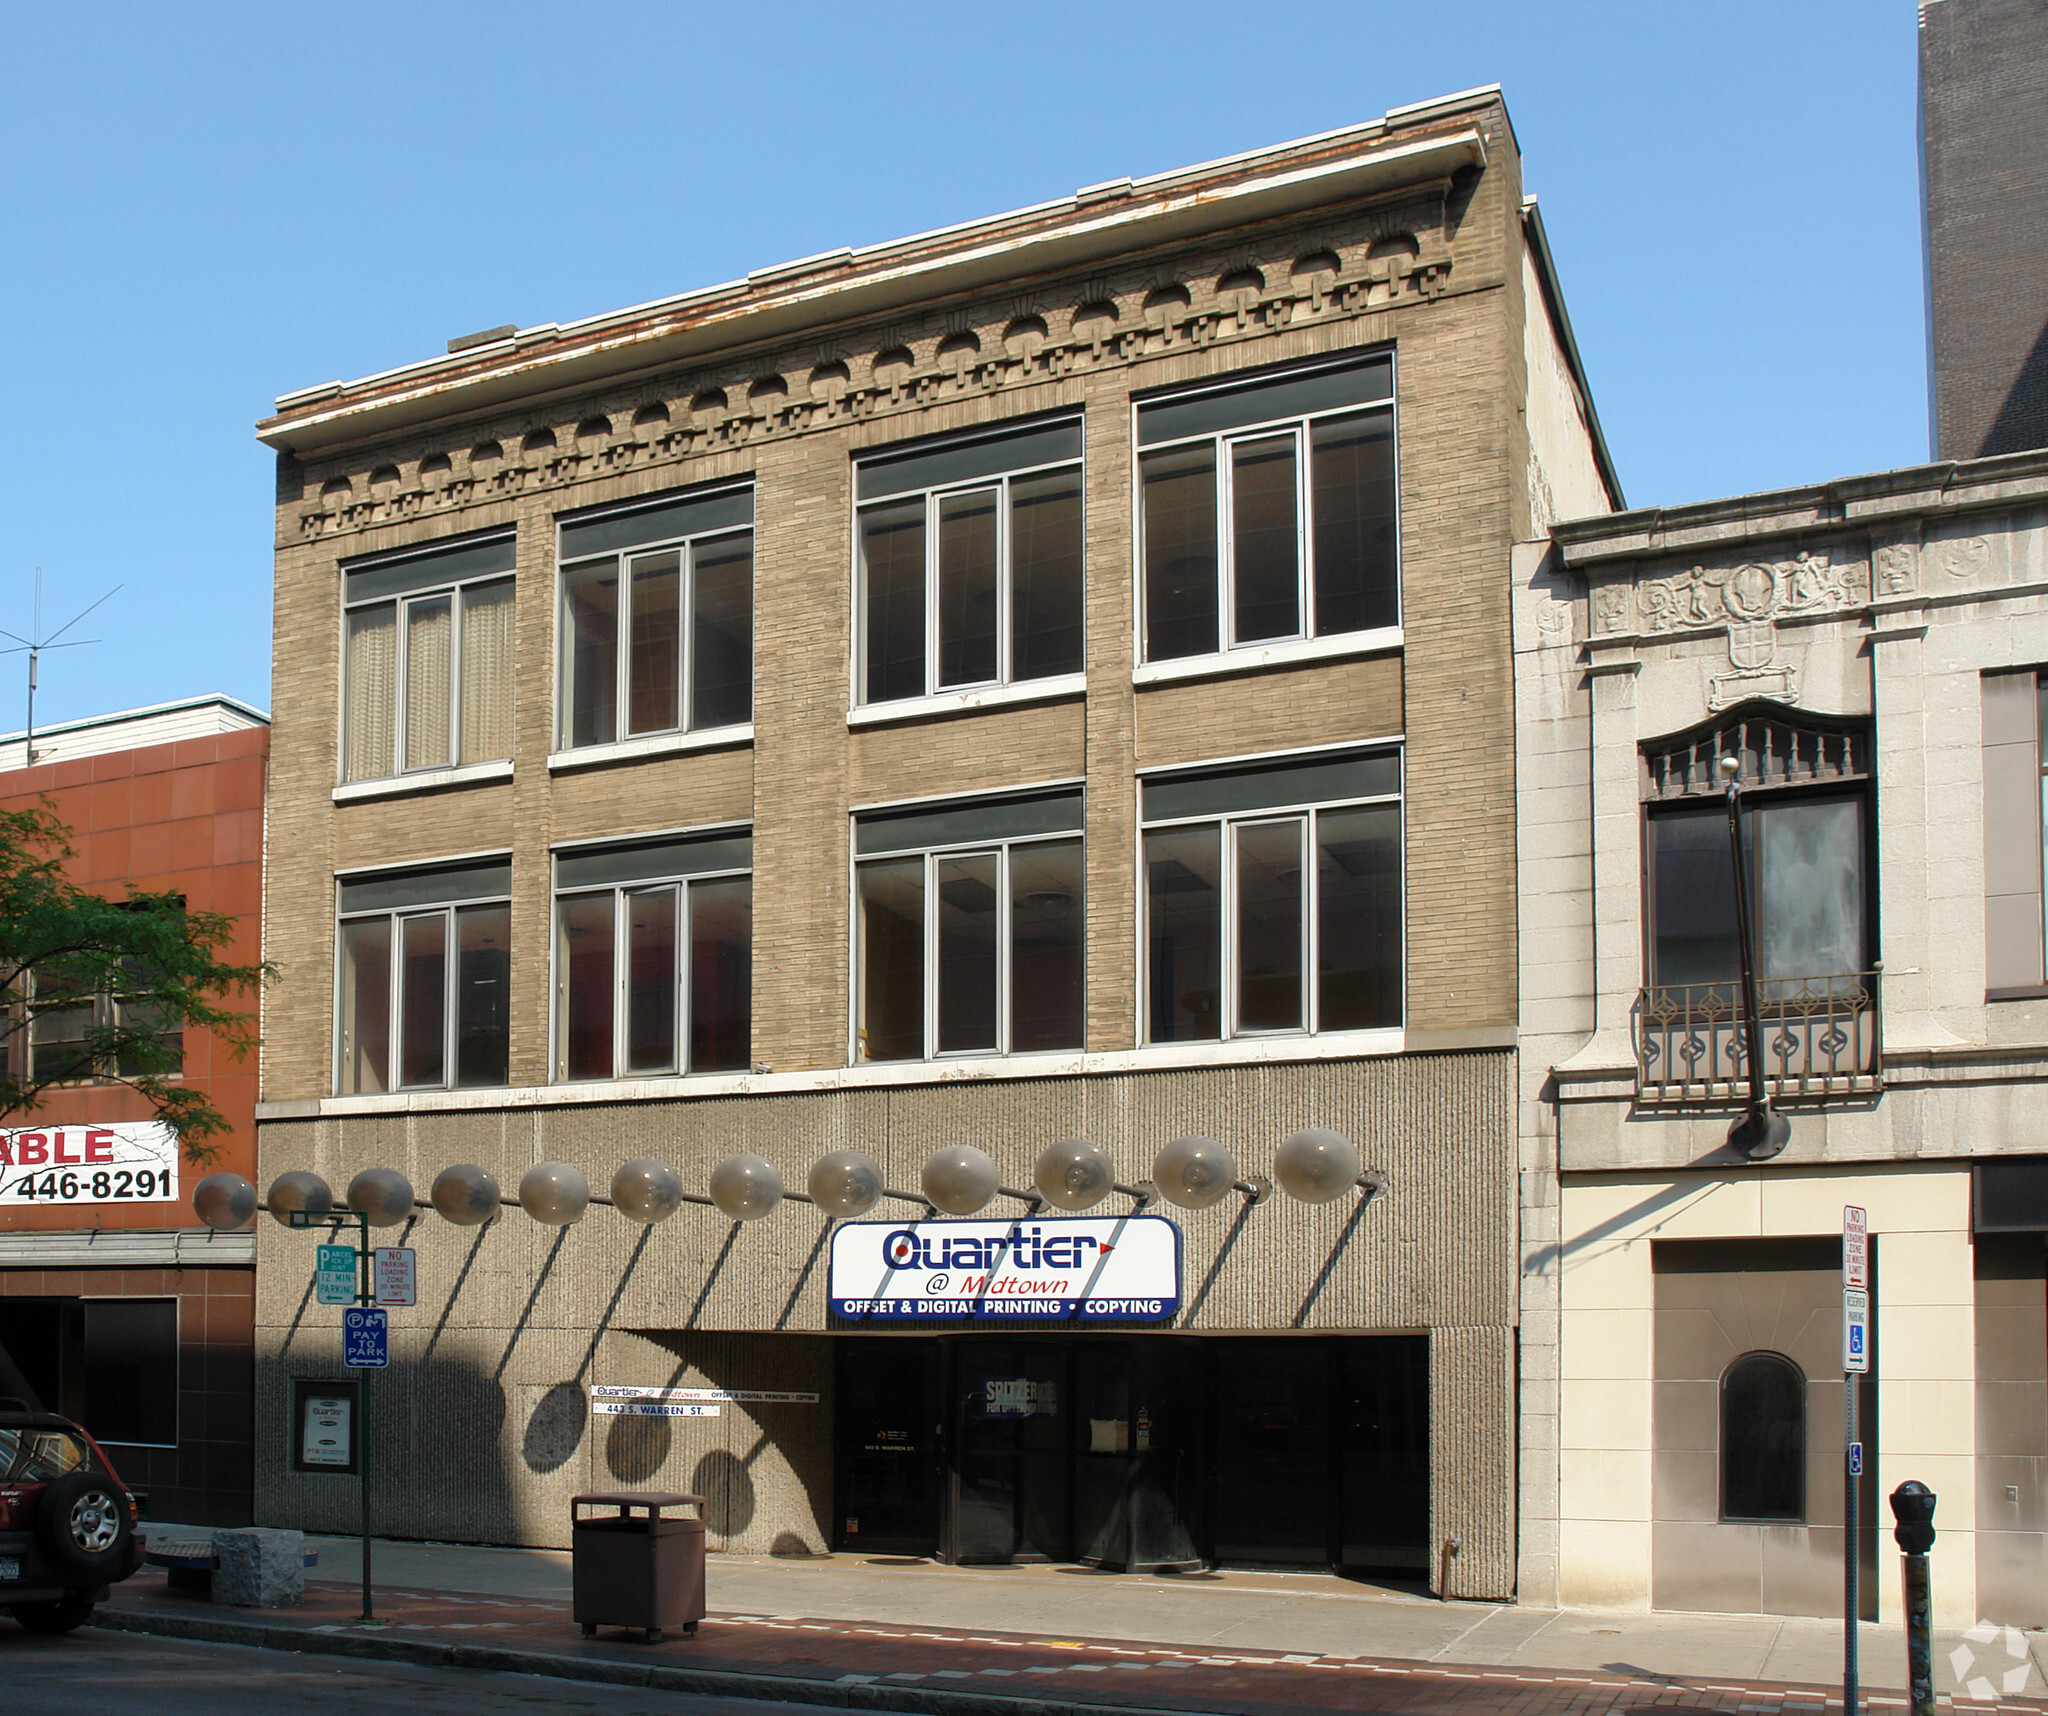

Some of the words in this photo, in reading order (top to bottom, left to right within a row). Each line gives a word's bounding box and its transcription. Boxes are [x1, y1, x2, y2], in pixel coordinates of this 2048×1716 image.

[17, 1169, 170, 1200] 446-8291
[1850, 1209, 1860, 1223] NO
[1846, 1223, 1865, 1234] PARKING
[1846, 1233, 1865, 1244] LOADING
[882, 1227, 1098, 1271] Quartier
[1849, 1243, 1862, 1254] ZONE
[388, 1251, 402, 1260] NO
[321, 1273, 331, 1282] 12
[320, 1284, 354, 1295] PARKING
[926, 1273, 949, 1295] @
[959, 1275, 1069, 1295] Midtown
[843, 1301, 895, 1314] OFFSET
[900, 1301, 912, 1314] &
[917, 1301, 976, 1314] DIGITAL
[984, 1300, 1060, 1314] PRINTING
[1085, 1300, 1162, 1314] COPYING
[353, 1331, 380, 1340] PAY
[358, 1340, 376, 1348] TO
[348, 1347, 385, 1357] PARK
[597, 1386, 640, 1396] Quartier
[660, 1390, 701, 1398] Midtown
[986, 1381, 1038, 1401] SPITZER
[607, 1405, 625, 1413] 443
[628, 1405, 637, 1413] S.
[640, 1406, 684, 1415] WARREN
[690, 1407, 704, 1415] ST.
